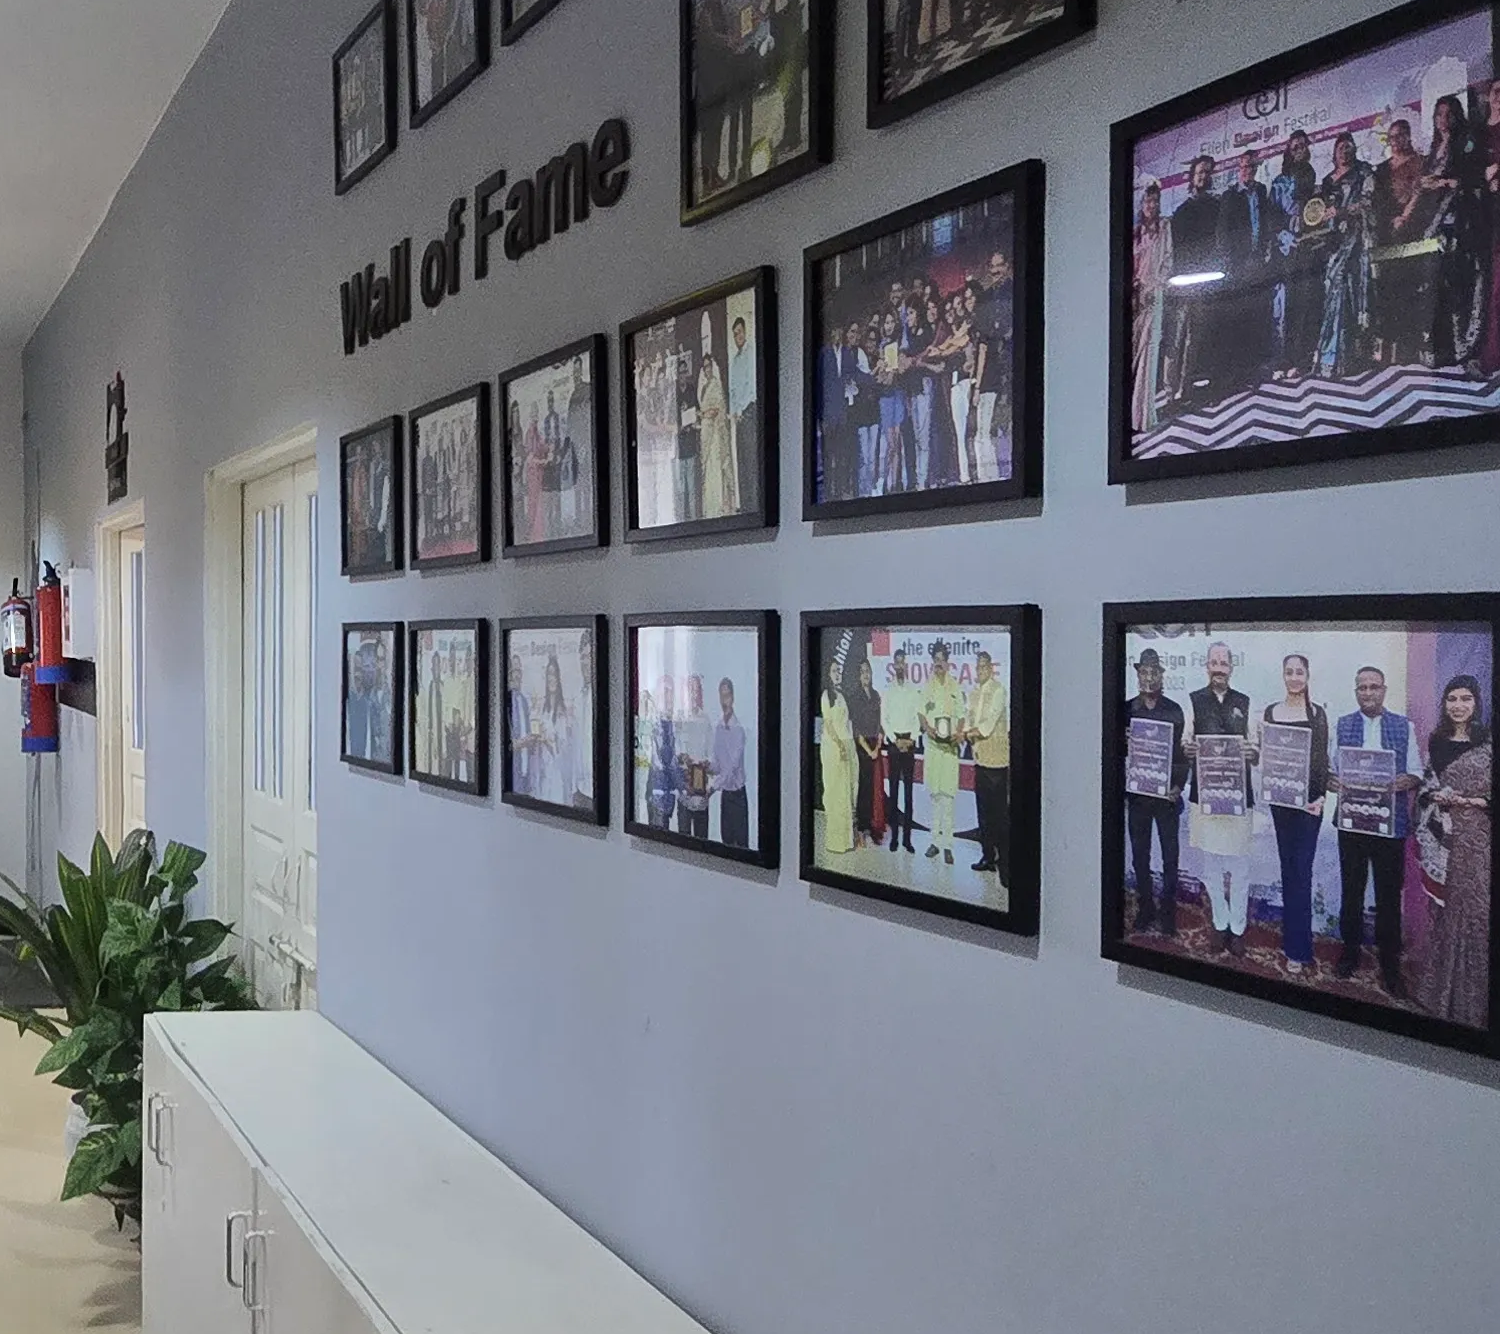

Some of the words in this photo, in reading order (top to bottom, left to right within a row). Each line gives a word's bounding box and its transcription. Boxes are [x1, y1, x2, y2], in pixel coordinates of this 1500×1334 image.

[340, 237, 411, 355] Wall
[420, 197, 466, 308] of
[473, 118, 631, 280] Fame
[902, 638, 924, 656] the
